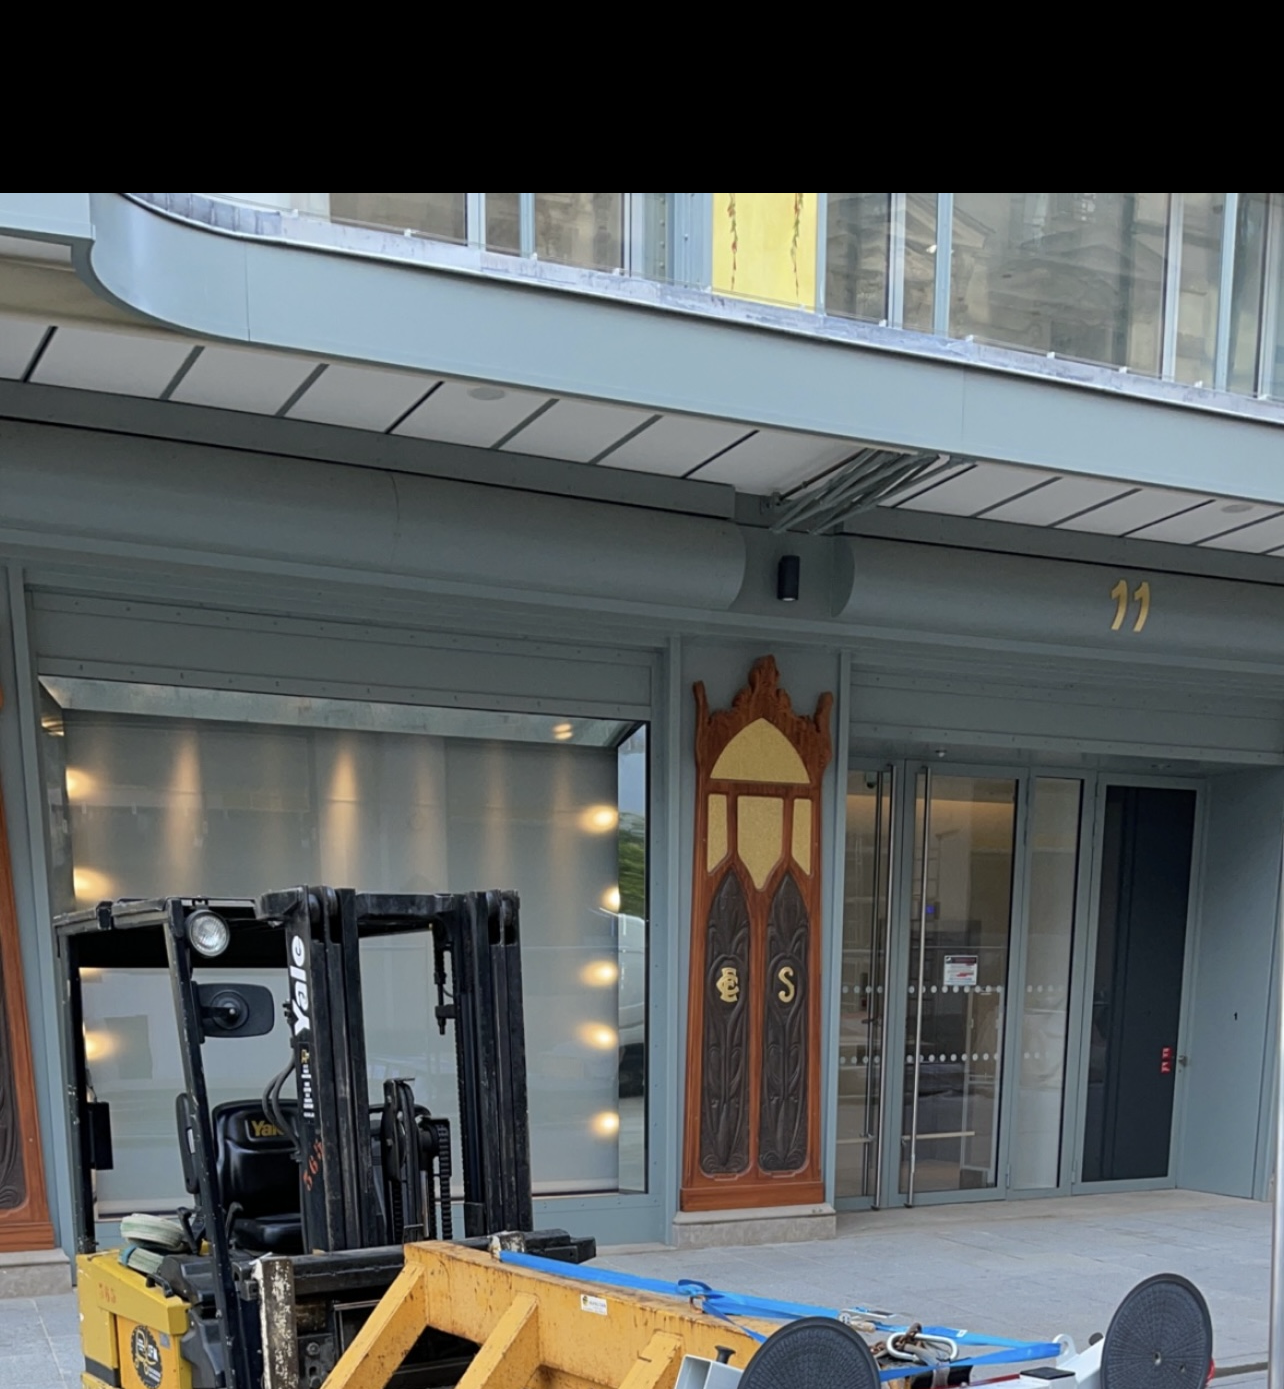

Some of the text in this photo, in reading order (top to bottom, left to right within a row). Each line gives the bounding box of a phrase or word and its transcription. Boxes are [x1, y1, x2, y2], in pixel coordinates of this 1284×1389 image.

[1110, 579, 1151, 632] 11
[290, 935, 311, 1036] Yale
[778, 966, 796, 1003] S
[251, 1120, 284, 1137] Yal
